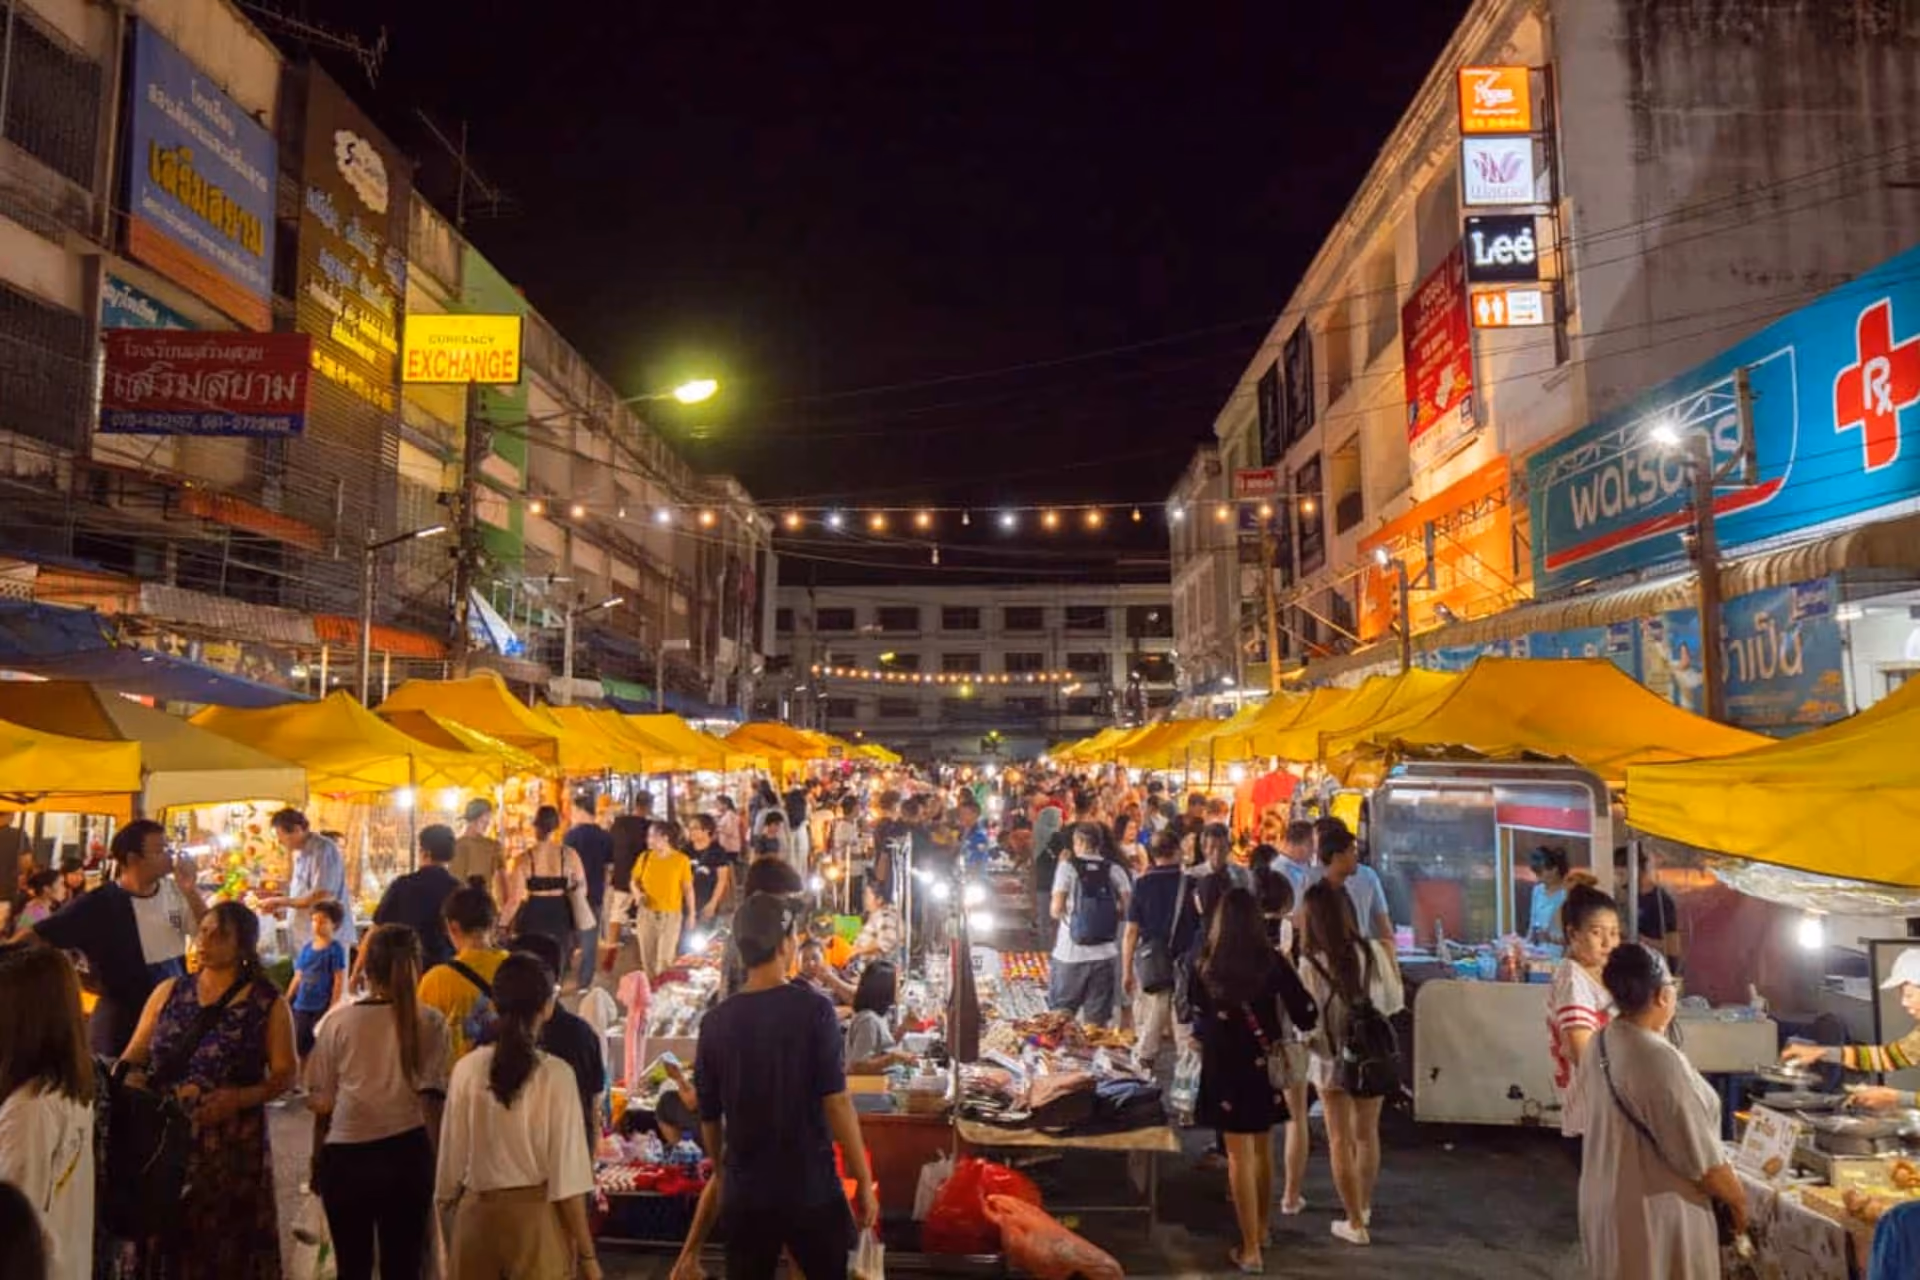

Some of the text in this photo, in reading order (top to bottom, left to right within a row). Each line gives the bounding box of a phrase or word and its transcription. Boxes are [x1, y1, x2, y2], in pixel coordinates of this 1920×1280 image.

[1472, 227, 1536, 266] Lee
[428, 334, 496, 345] CURRENCY
[407, 349, 513, 379] EXCHANGE
